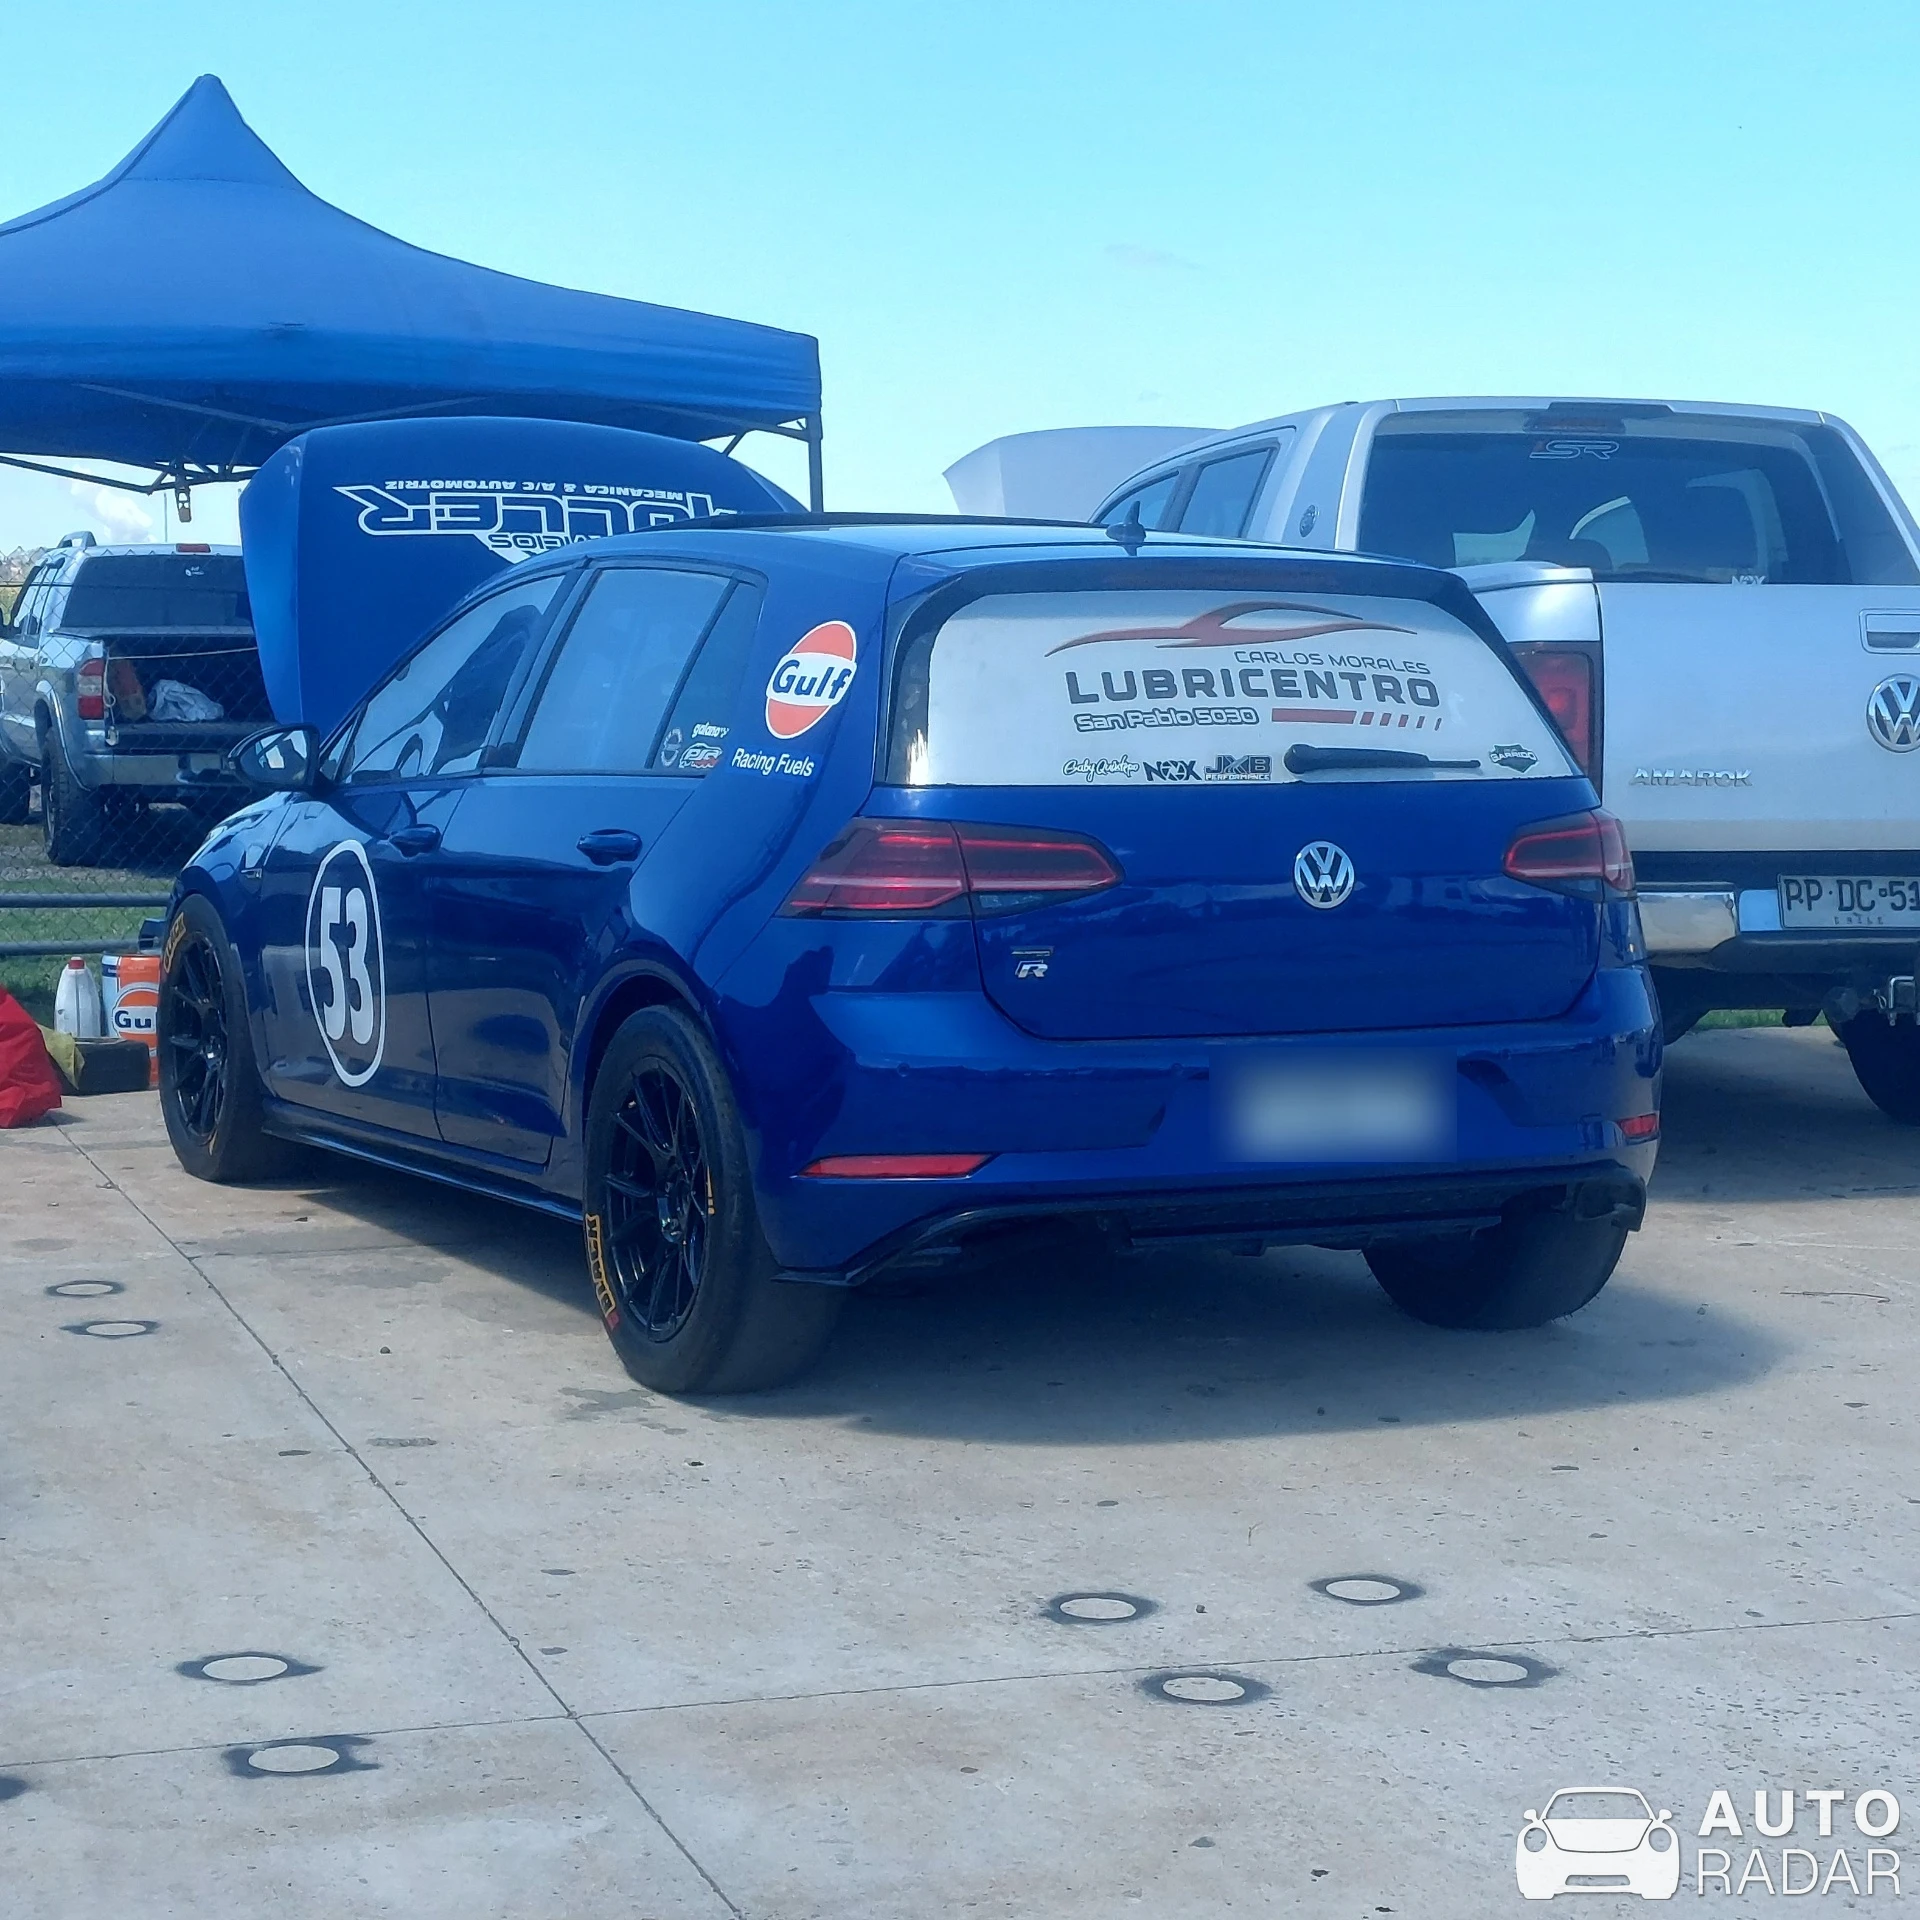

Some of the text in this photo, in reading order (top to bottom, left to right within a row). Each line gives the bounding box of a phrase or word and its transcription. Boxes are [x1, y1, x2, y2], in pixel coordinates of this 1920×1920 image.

[1529, 440, 1620, 459] SR
[384, 480, 683, 500] MECANICA & A/C AUTOMOTRIZ
[1234, 650, 1431, 675] CARLOS MORALES
[772, 659, 852, 699] Gulf
[1065, 668, 1440, 707] LUBRICENTRO
[1074, 707, 1260, 732] San Pablo 5030
[731, 748, 815, 777] Racing Fuels
[1143, 760, 1202, 781] NOX
[1205, 774, 1272, 782] PERFORMANCE
[1629, 768, 1752, 786] AMAROK
[320, 887, 374, 1045] 53
[1015, 960, 1048, 978] R
[114, 1010, 158, 1029] Gu
